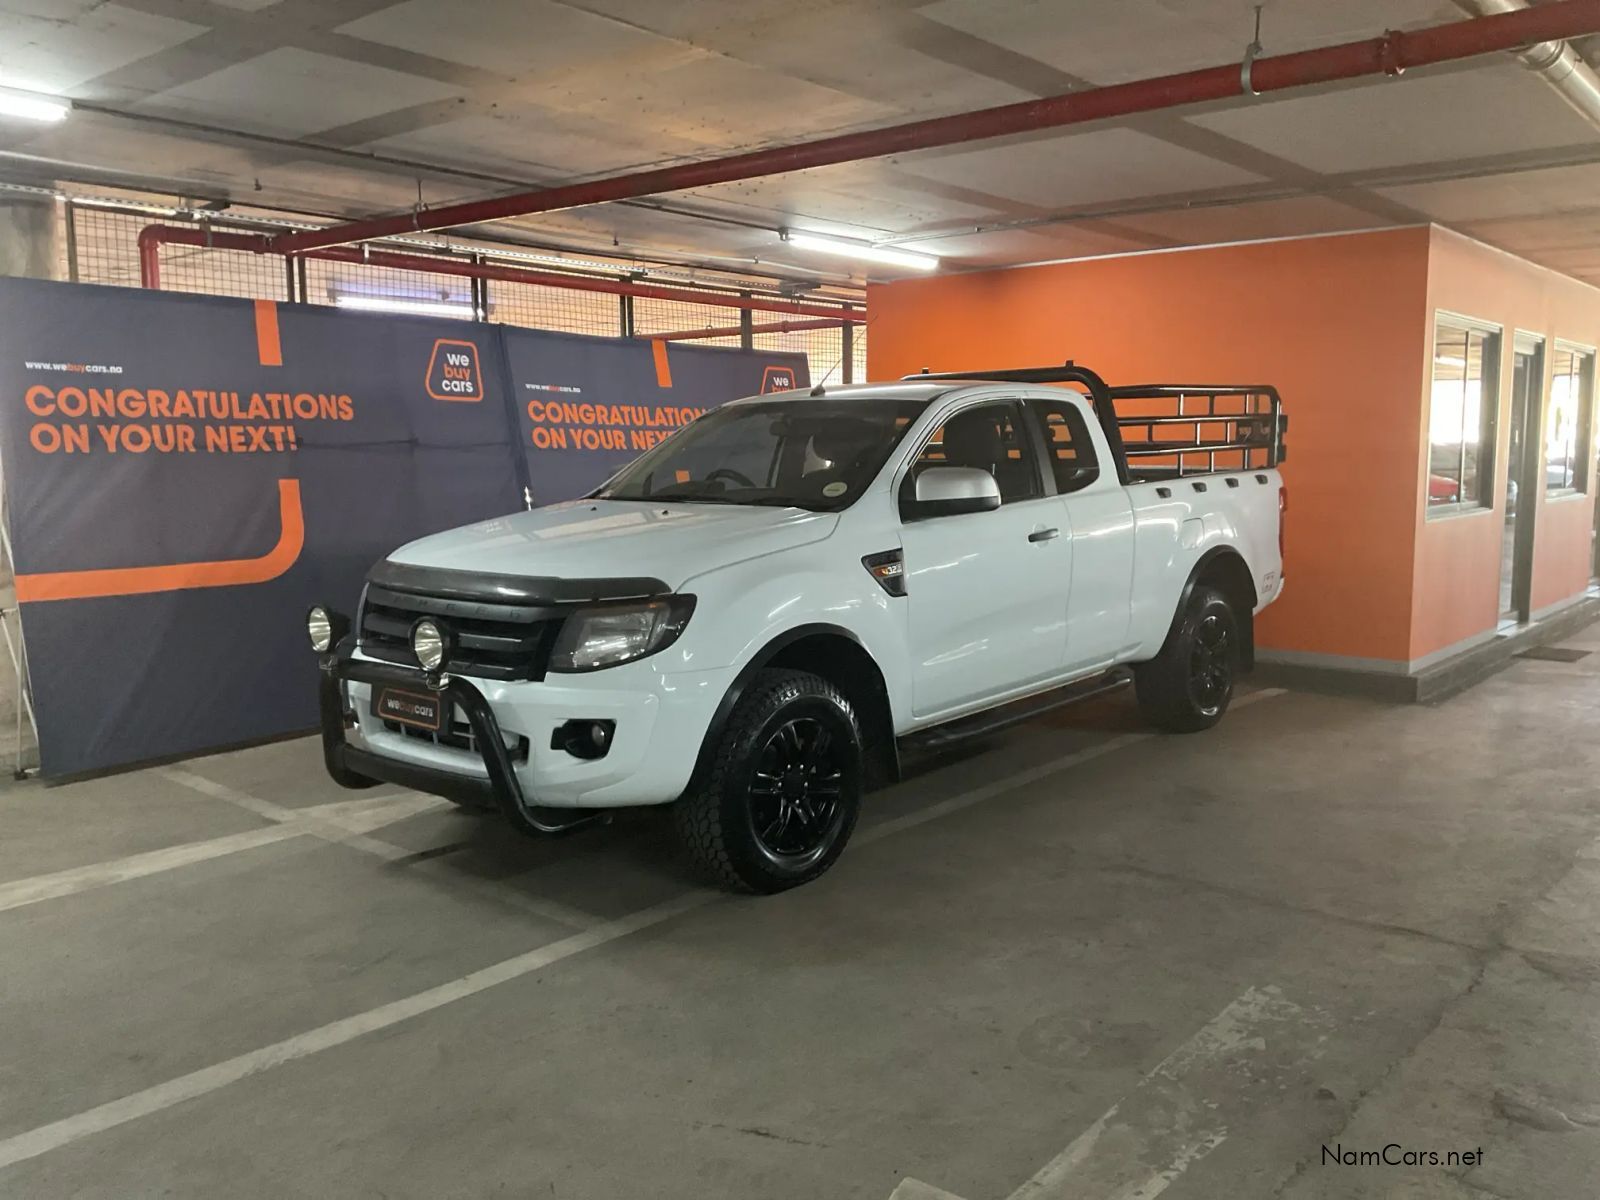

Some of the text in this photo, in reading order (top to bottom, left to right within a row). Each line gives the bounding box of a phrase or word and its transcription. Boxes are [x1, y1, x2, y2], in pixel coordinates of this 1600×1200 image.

[24, 361, 123, 374] www.webuycars.na
[446, 353, 470, 367] we
[443, 363, 471, 381] buy
[441, 379, 474, 393] cars
[773, 376, 789, 387] we
[24, 384, 354, 421] CONGRATULATIONS
[30, 423, 299, 454] ON YOUR NEXT!
[532, 426, 674, 451] ON YOUR NEX
